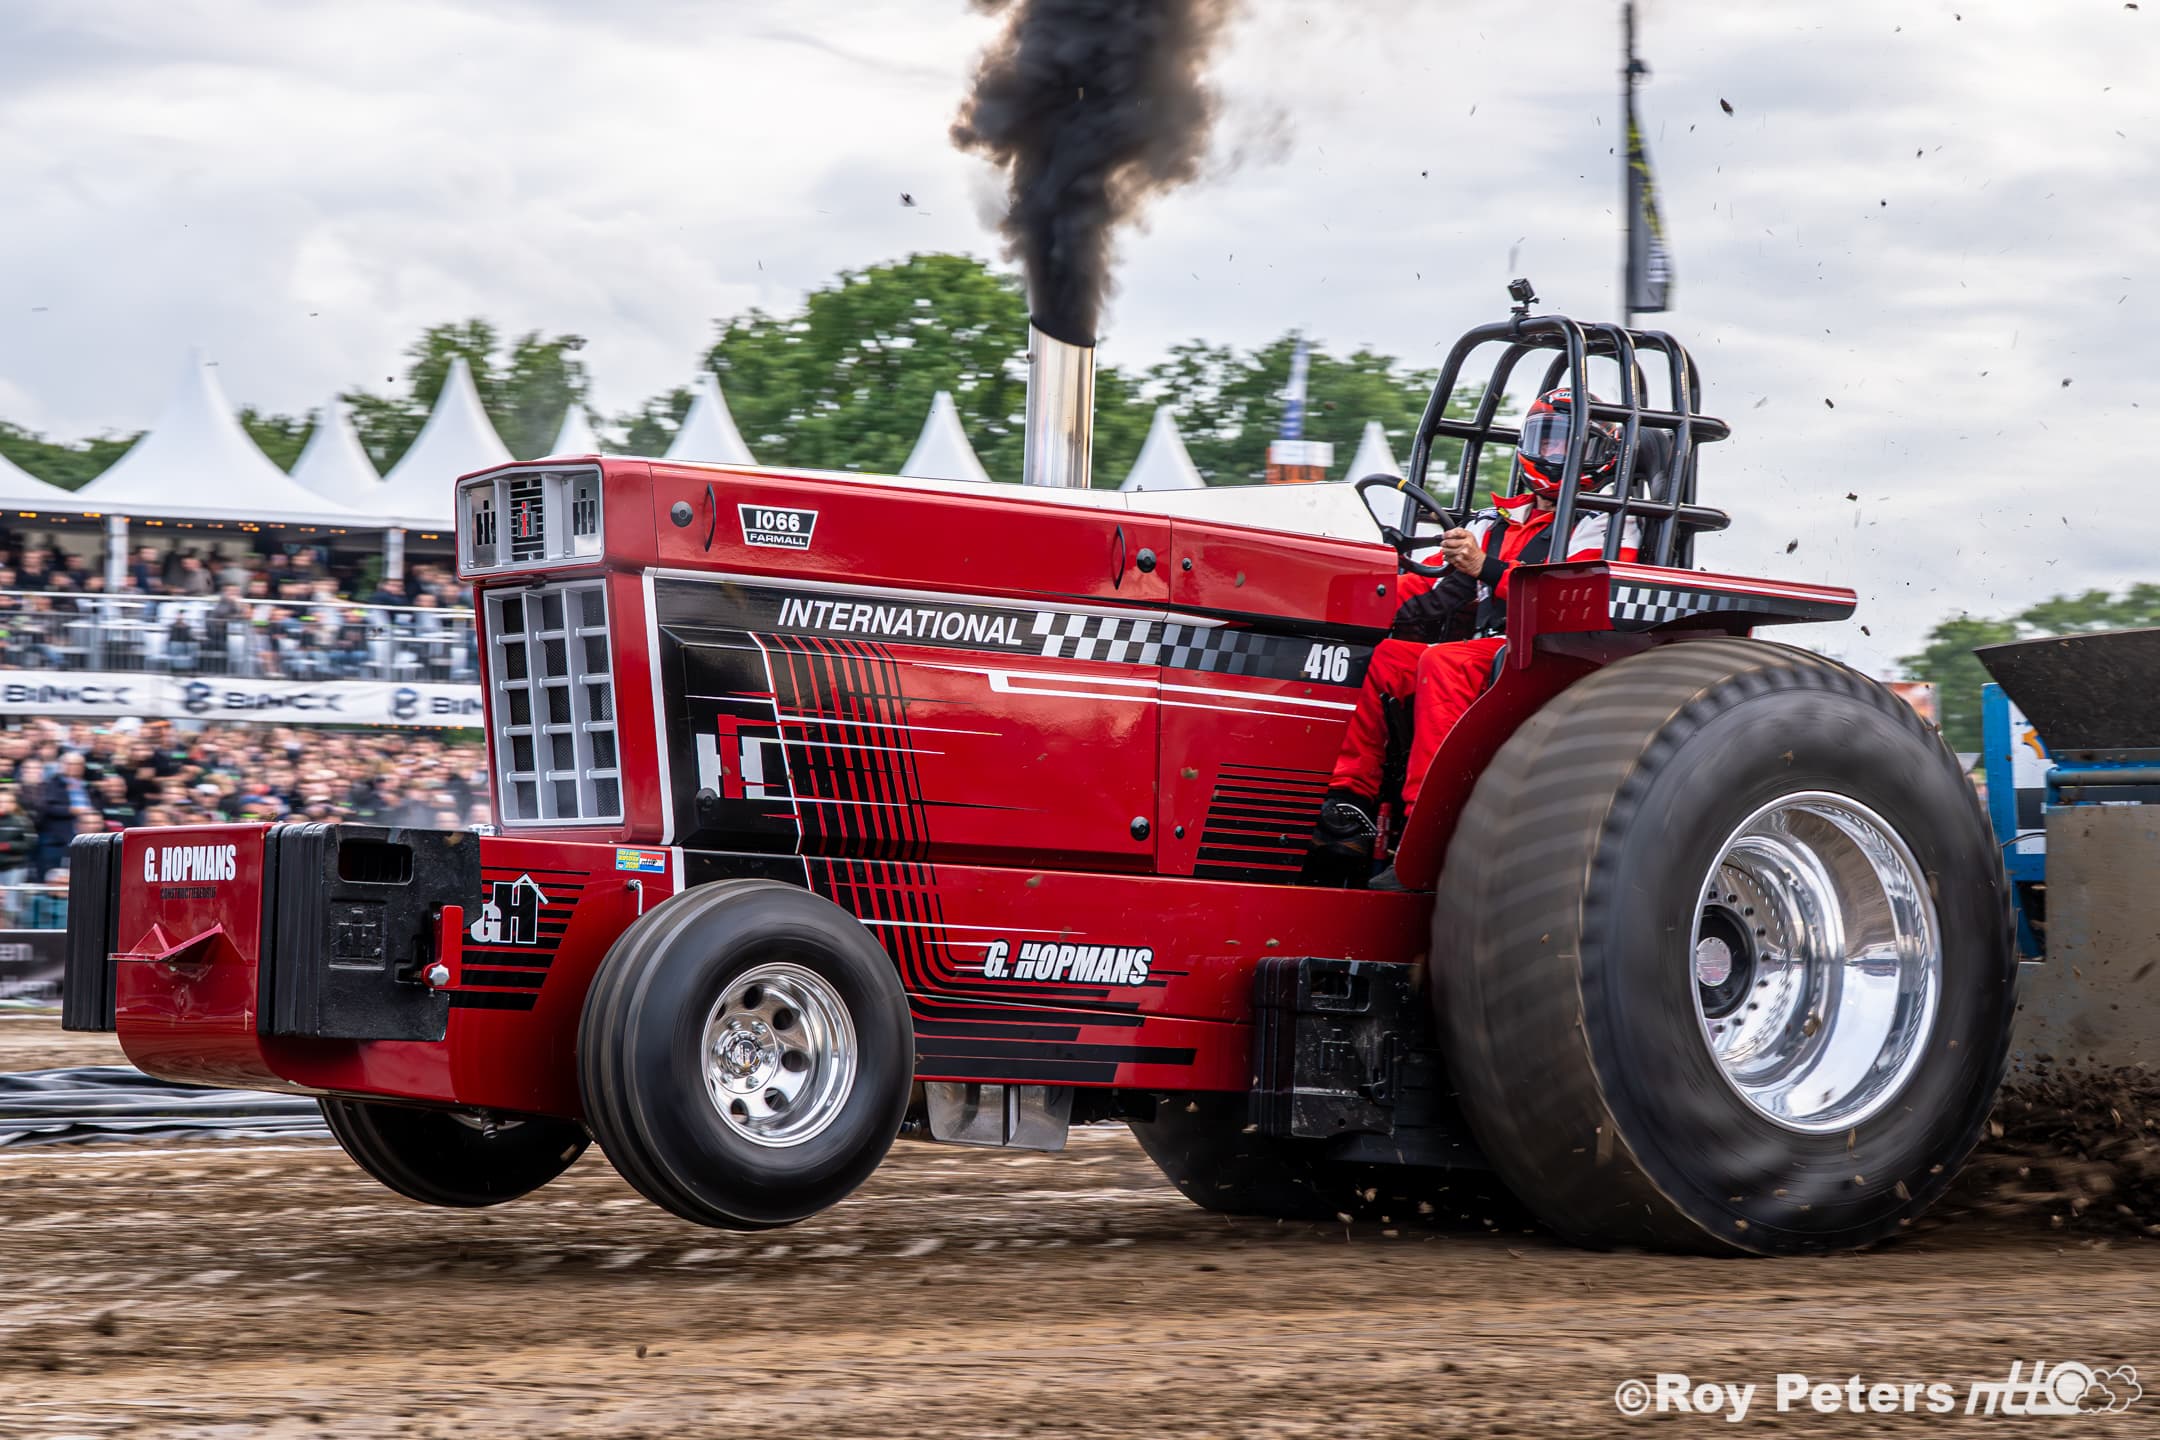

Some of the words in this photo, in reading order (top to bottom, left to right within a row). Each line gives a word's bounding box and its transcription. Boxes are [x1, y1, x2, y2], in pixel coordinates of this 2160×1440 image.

[750, 534, 806, 545] FARMALL
[756, 511, 800, 532] 1066
[777, 598, 1023, 646] INTERNATIONAL
[1304, 643, 1350, 682] 416
[144, 847, 158, 882] G.
[161, 845, 237, 882] HOPMANS
[984, 941, 1009, 978] G.
[1014, 943, 1153, 985] HOPMANS
